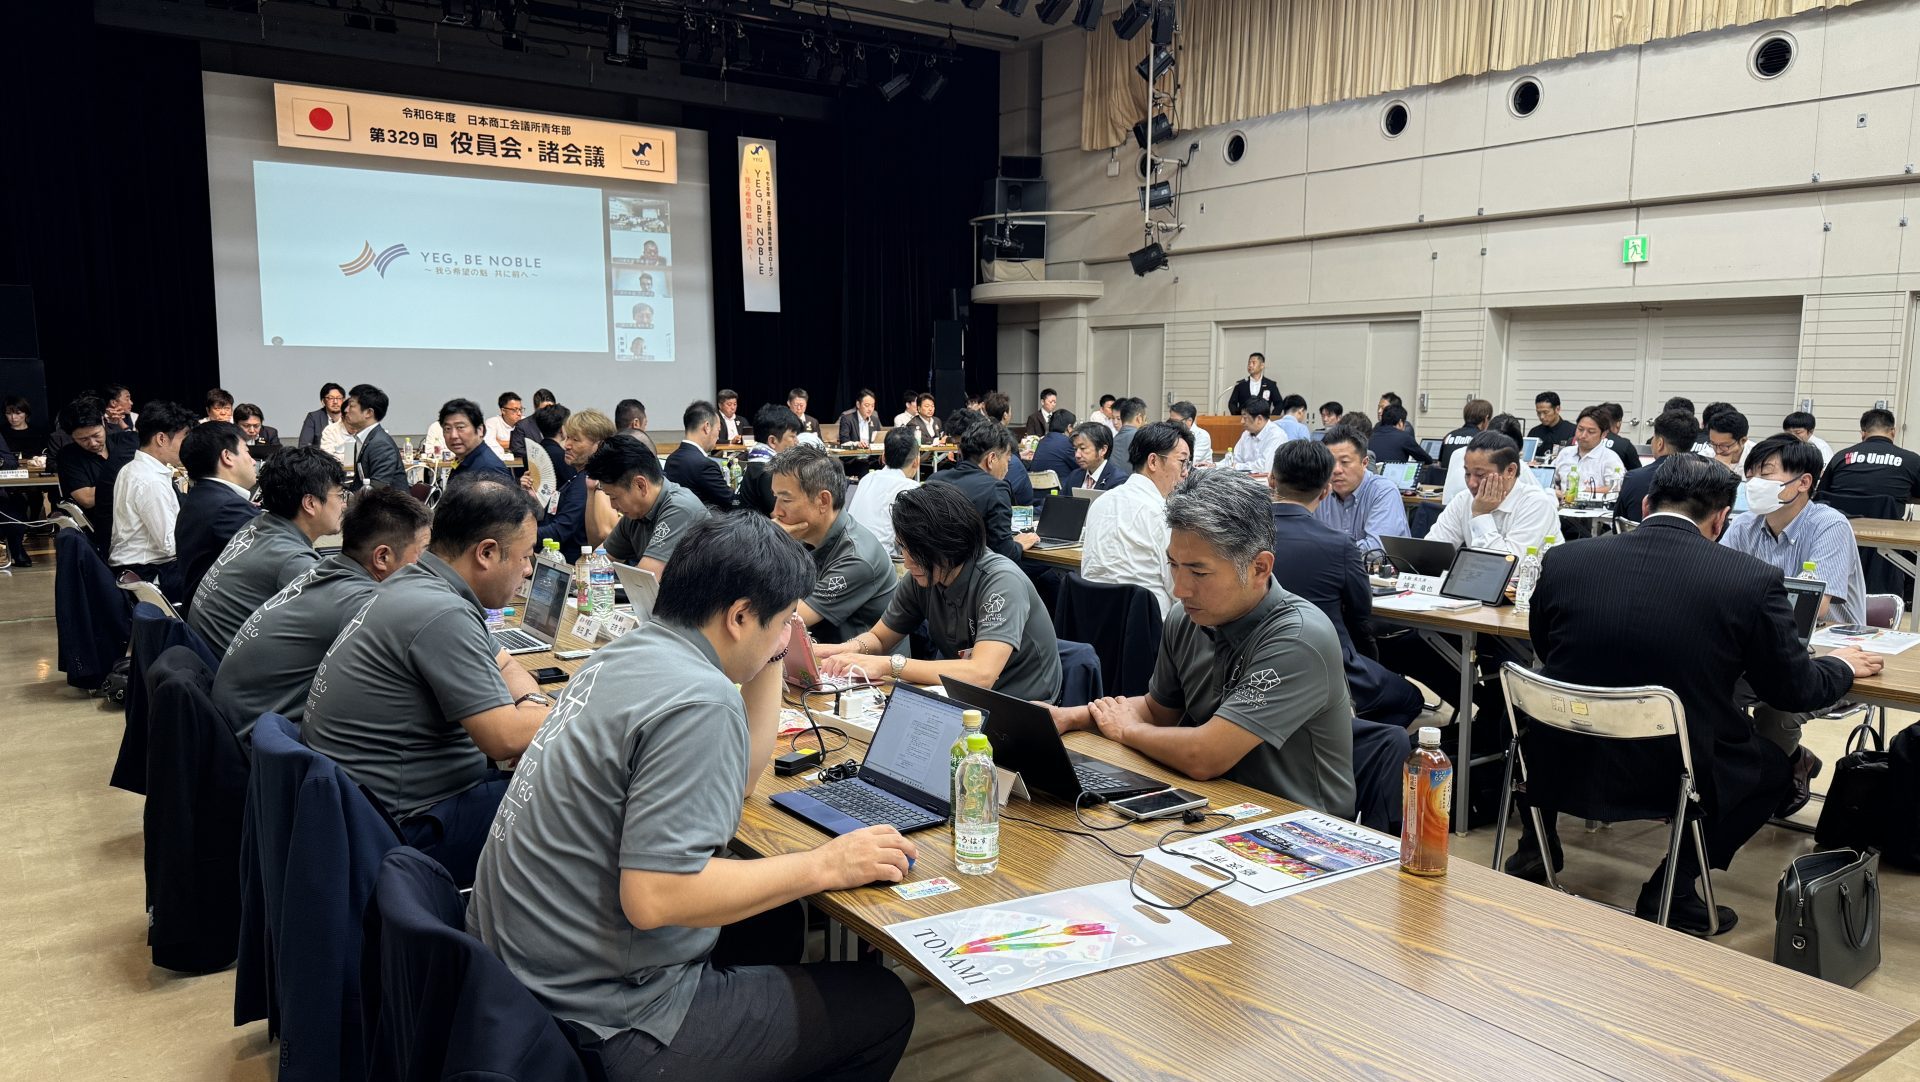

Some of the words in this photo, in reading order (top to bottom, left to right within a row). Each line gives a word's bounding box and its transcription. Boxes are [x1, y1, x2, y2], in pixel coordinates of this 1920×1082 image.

[402, 107, 456, 124] 令和6年度
[467, 115, 572, 136] 日本商工会議所青年部
[369, 127, 438, 148] 第329回
[450, 131, 606, 169] 役員会・諸会議
[755, 169, 763, 202] YEG,
[757, 205, 763, 223] BE
[420, 252, 458, 266] YEG,
[464, 254, 482, 265] BE
[489, 256, 541, 268] NOBLE
[1867, 453, 1903, 467] Unite
[912, 928, 991, 986] TONAMI
